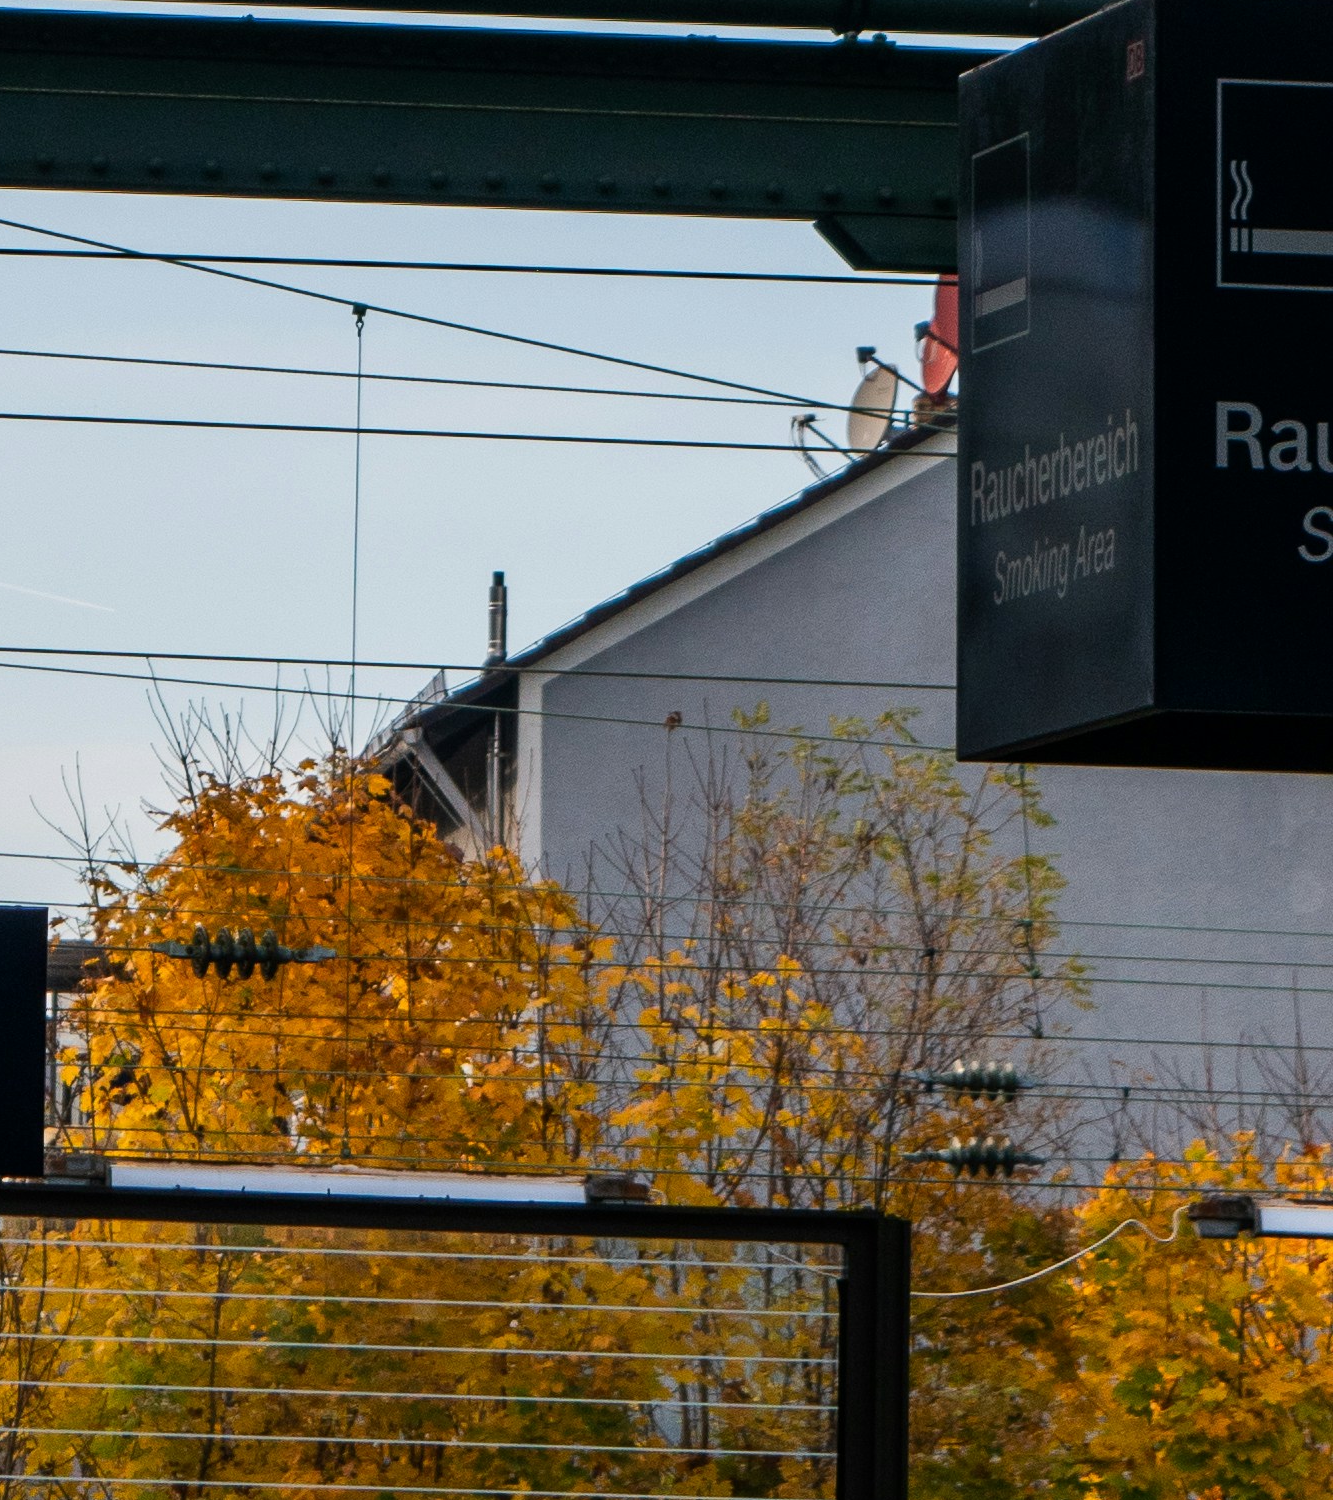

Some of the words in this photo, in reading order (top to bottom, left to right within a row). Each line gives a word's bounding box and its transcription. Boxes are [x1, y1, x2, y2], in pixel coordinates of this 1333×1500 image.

[970, 408, 1139, 527] Raucherbereich
[992, 539, 1069, 606] Smoking
[1073, 524, 1117, 582] Area
